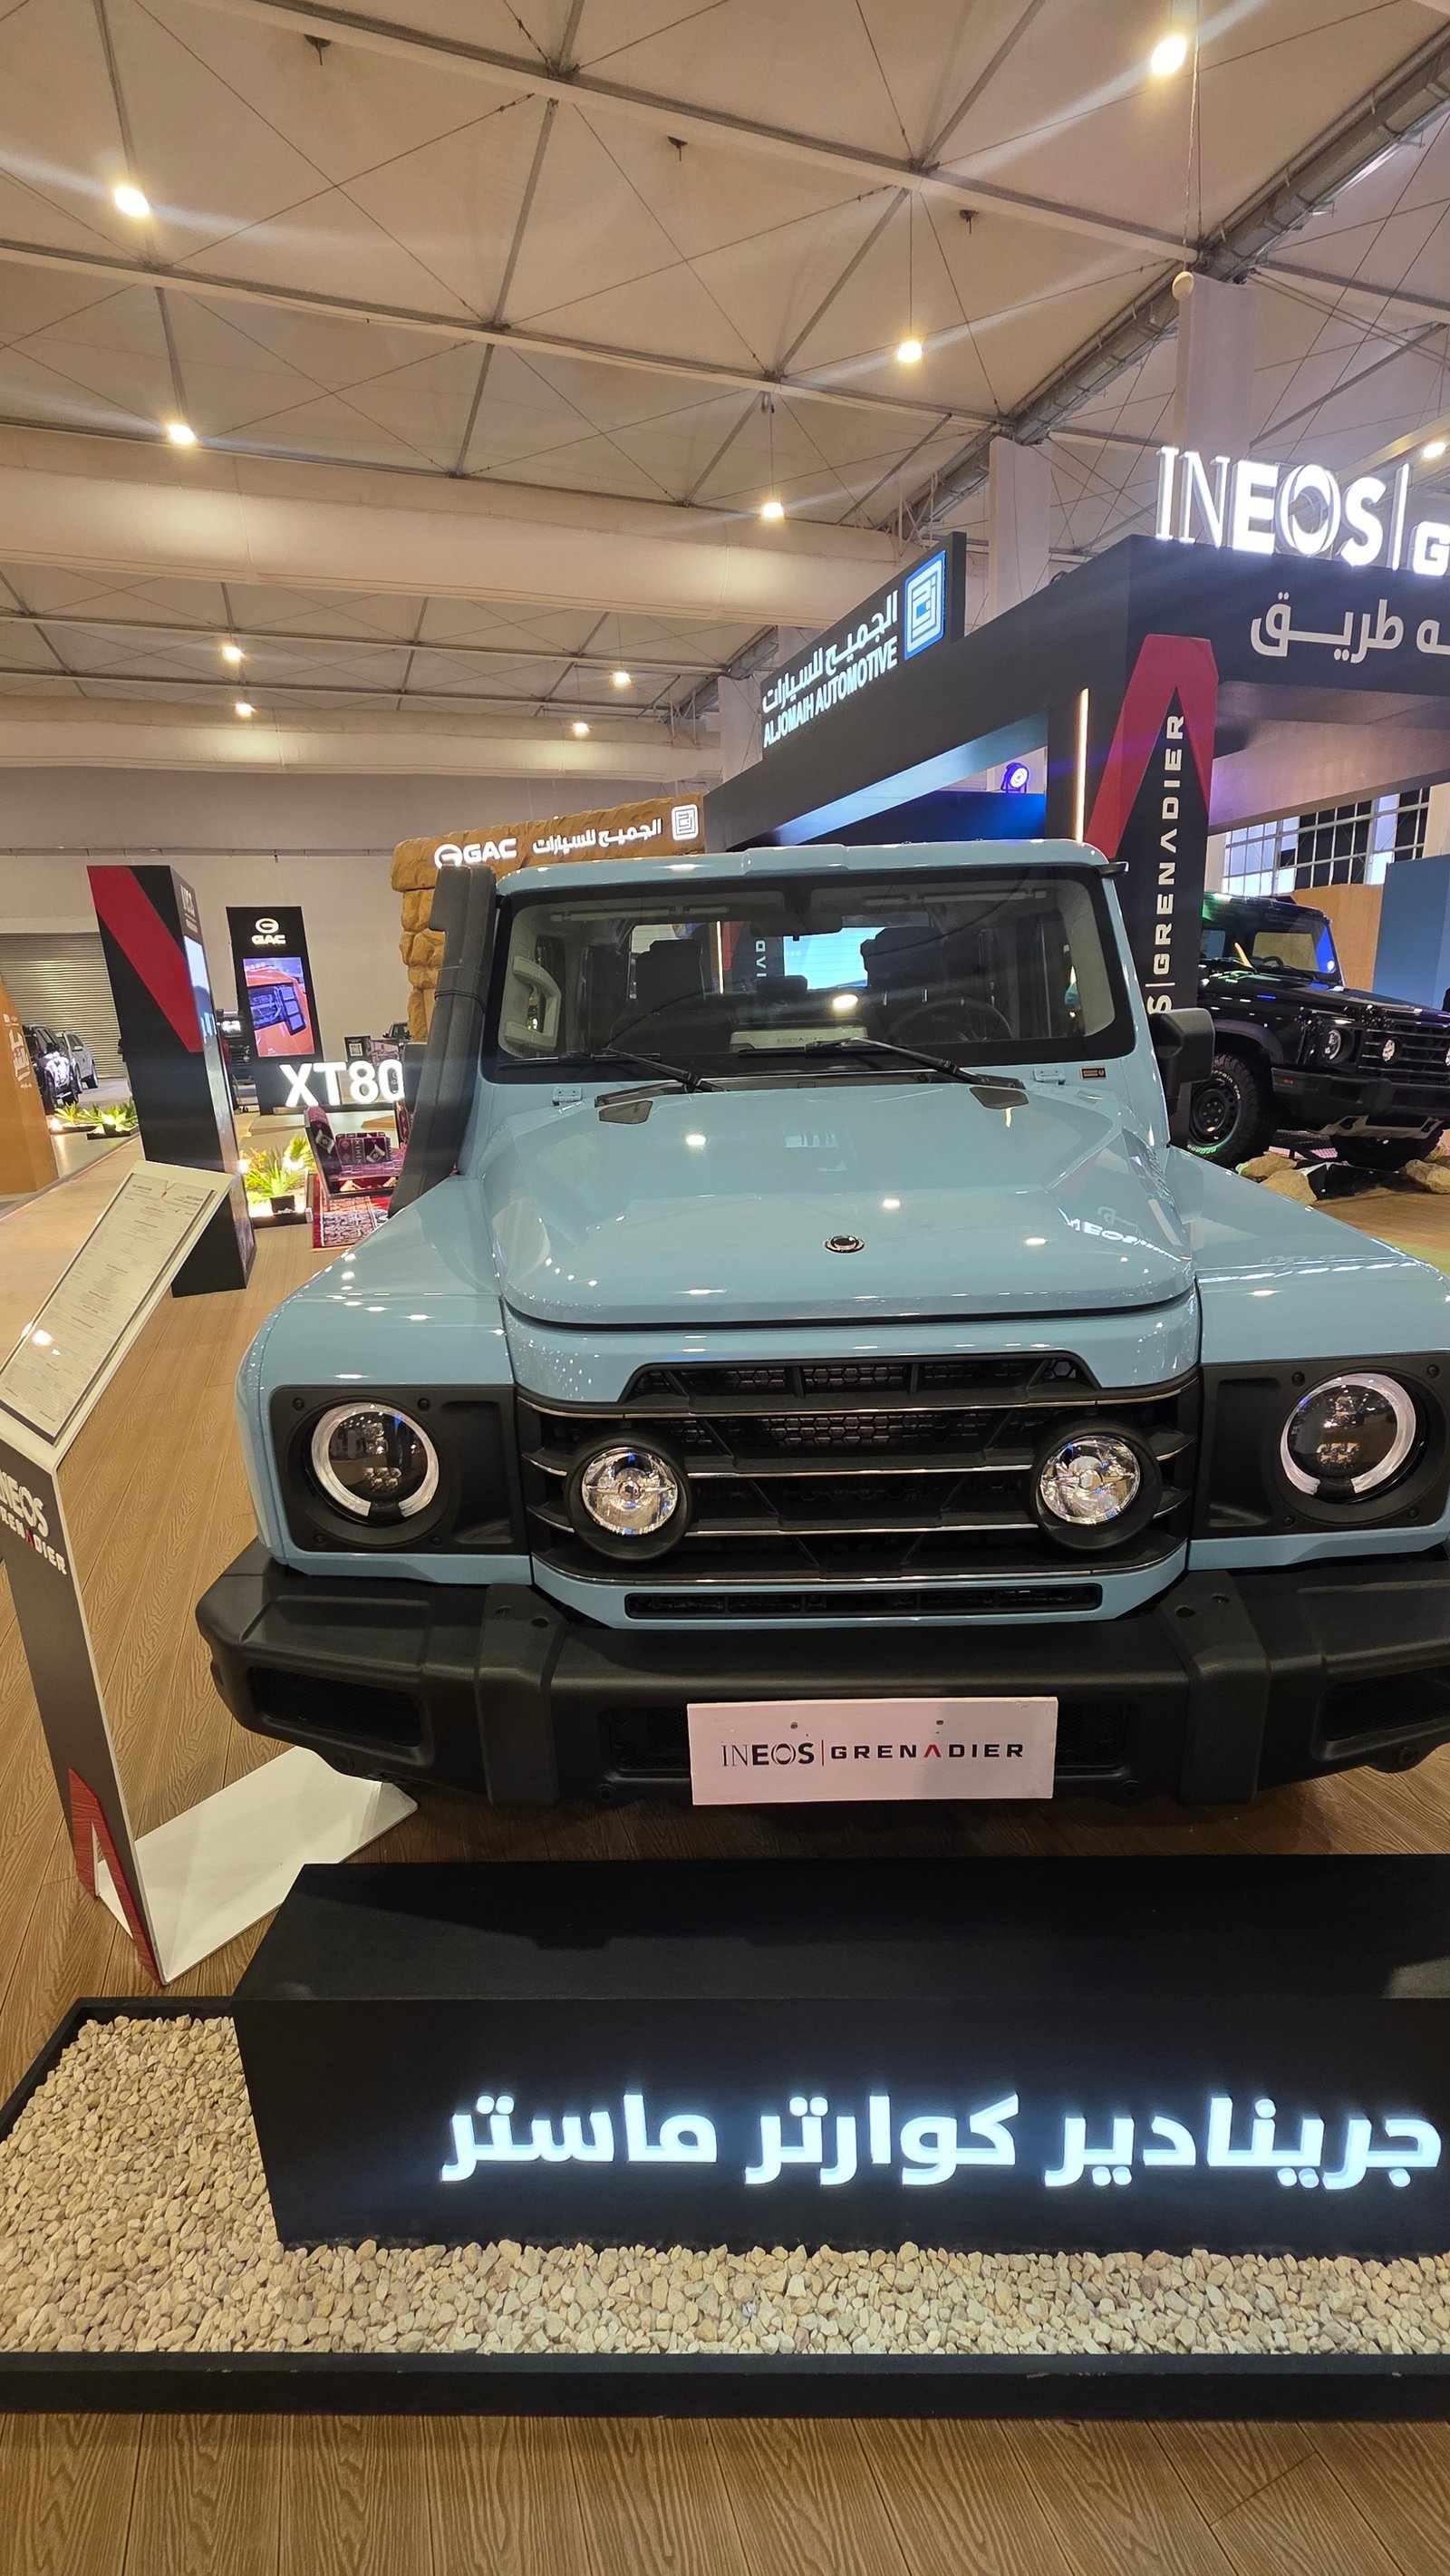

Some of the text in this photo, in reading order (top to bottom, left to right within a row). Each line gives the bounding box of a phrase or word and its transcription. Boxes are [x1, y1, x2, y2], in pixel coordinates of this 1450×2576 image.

[1156, 445, 1387, 567] INEOS
[762, 589, 898, 714] الجميح للسيارات
[763, 635, 898, 749] ALJOMAIH AUTOMOTIVE
[462, 838, 517, 865] GAC
[532, 818, 662, 856] الجميح للسيارات
[1153, 715, 1184, 974] GRENADIER
[251, 935, 286, 945] GAC
[721, 1742, 1024, 1767] INEOS GRENADIER
[440, 2093, 1442, 2191] جرينادير كوارتر ماستر
